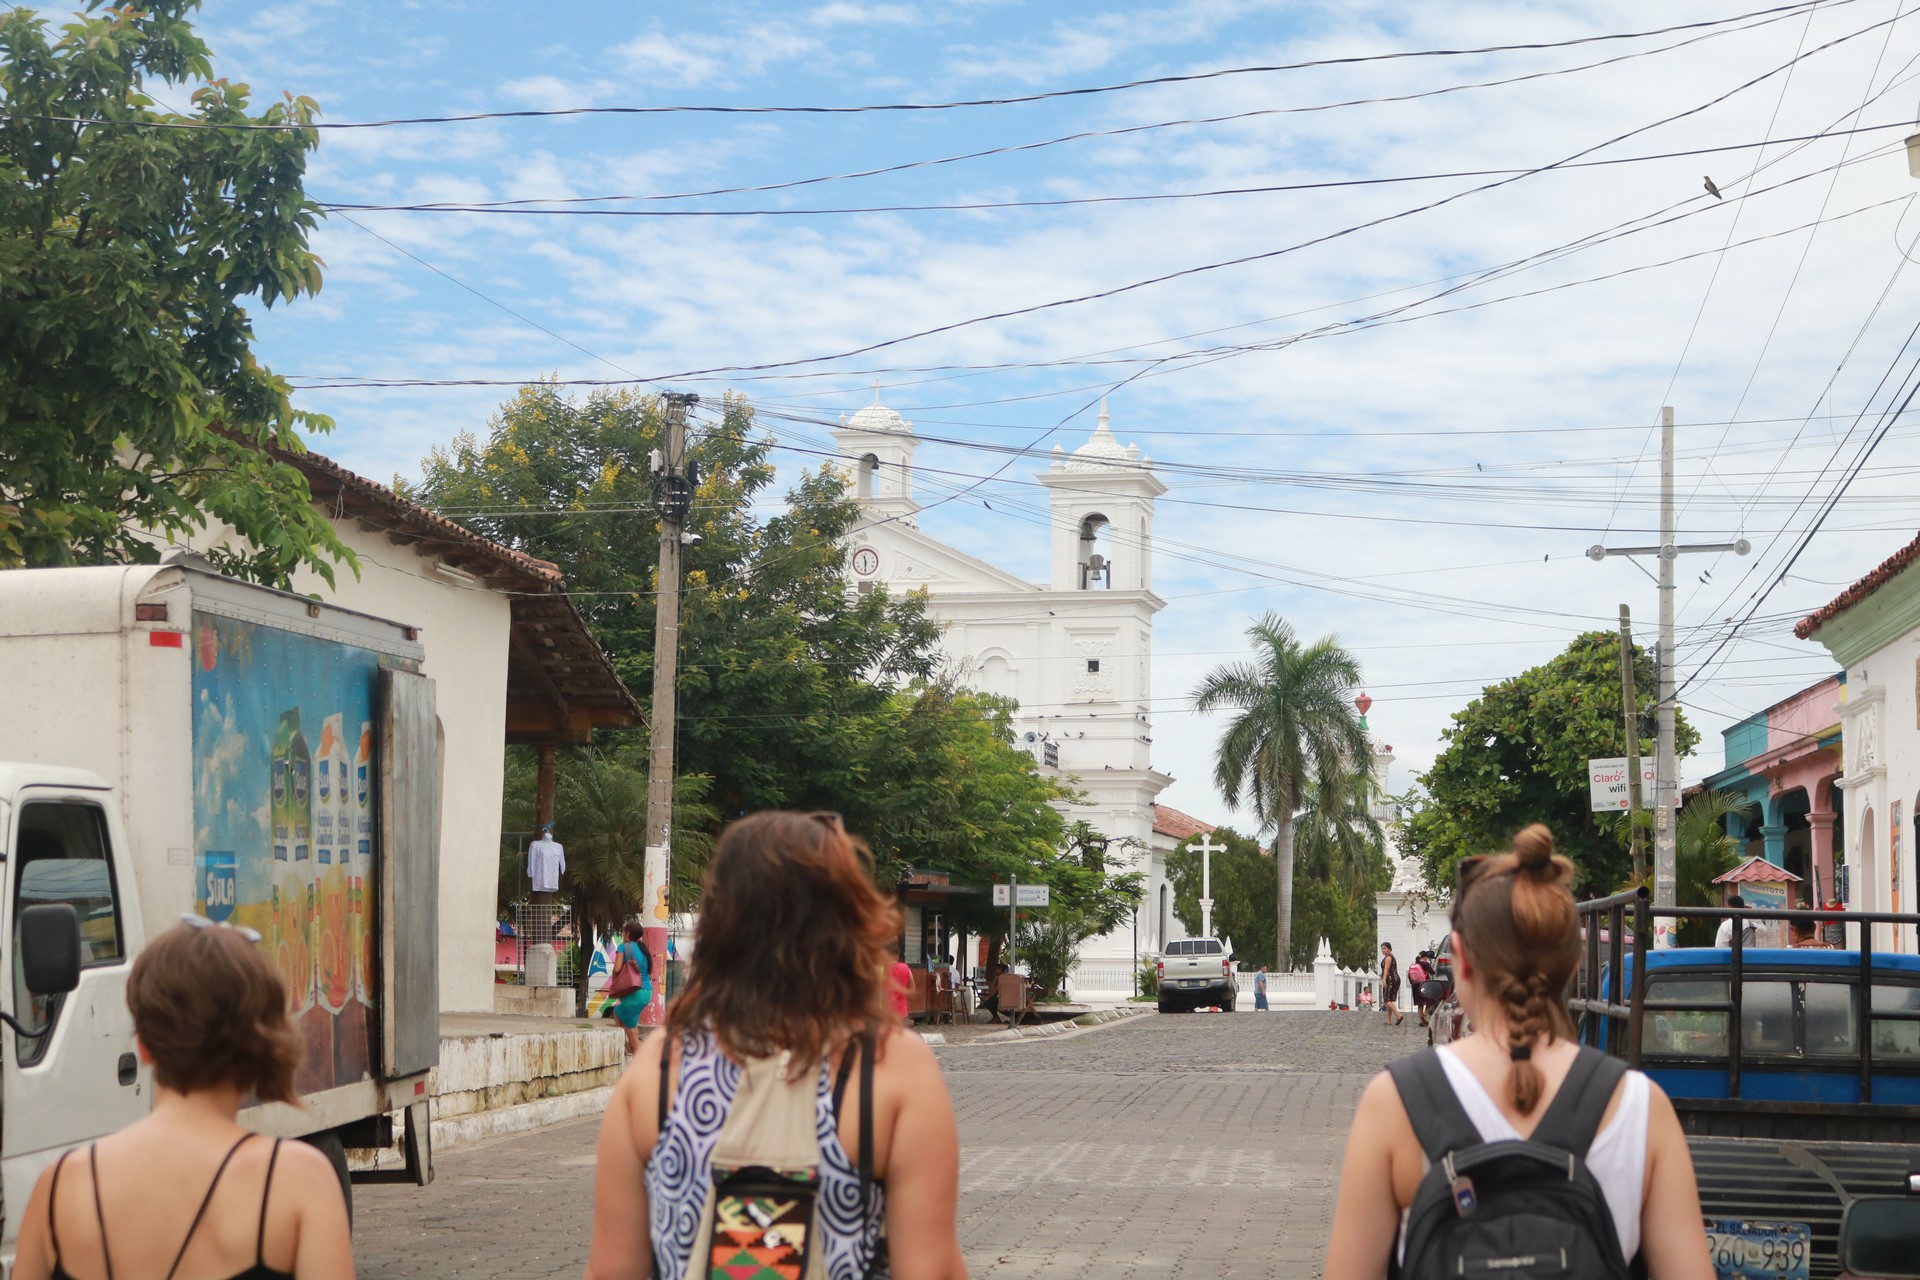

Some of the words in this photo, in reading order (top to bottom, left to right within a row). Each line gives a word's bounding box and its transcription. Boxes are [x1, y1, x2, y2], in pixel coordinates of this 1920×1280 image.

[1593, 773, 1621, 783] Claro
[1609, 783, 1627, 793] wifi
[207, 872, 234, 907] SULA
[1716, 1223, 1728, 1234] EL
[1730, 1224, 1778, 1238] SALVADOR
